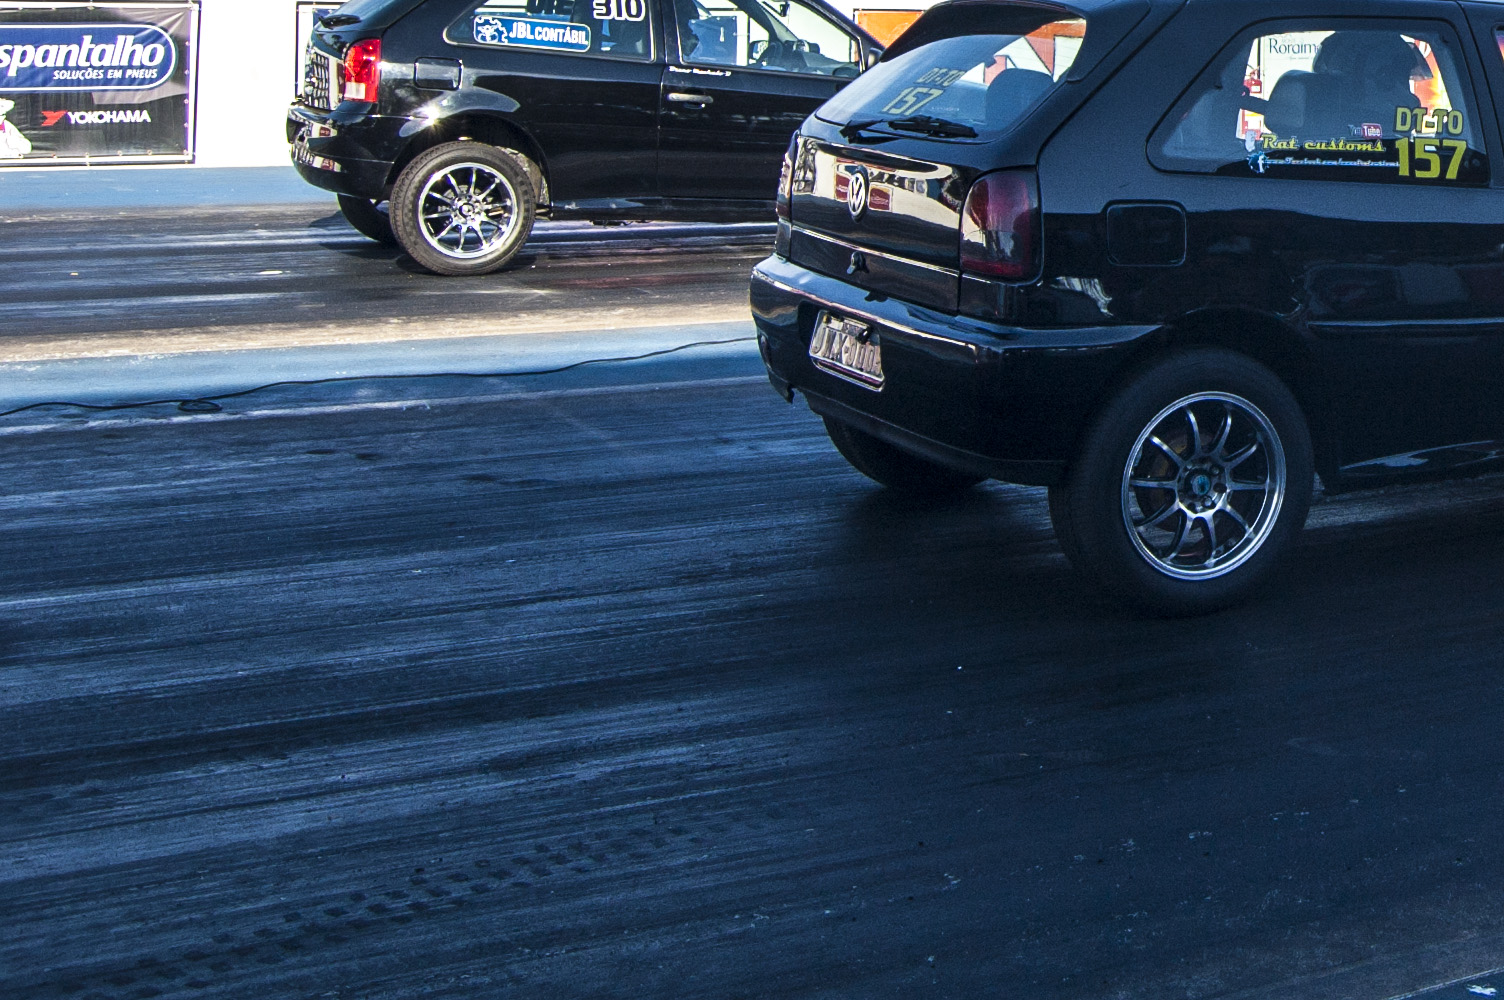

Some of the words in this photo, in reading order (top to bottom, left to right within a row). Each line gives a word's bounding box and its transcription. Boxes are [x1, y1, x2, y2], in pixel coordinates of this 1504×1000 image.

[509, 22, 534, 40] JBL
[534, 27, 588, 45] CONTÁBIL
[1268, 38, 1319, 55] Roraim
[53, 68, 104, 80] SOLUÇÕES
[107, 70, 122, 79] EM
[125, 69, 158, 79] PNEUS
[881, 87, 944, 116] 157
[67, 109, 151, 124] YOKOHAMA
[1261, 134, 1298, 150] Rat
[1304, 138, 1386, 152] customs
[1395, 137, 1467, 180] 157
